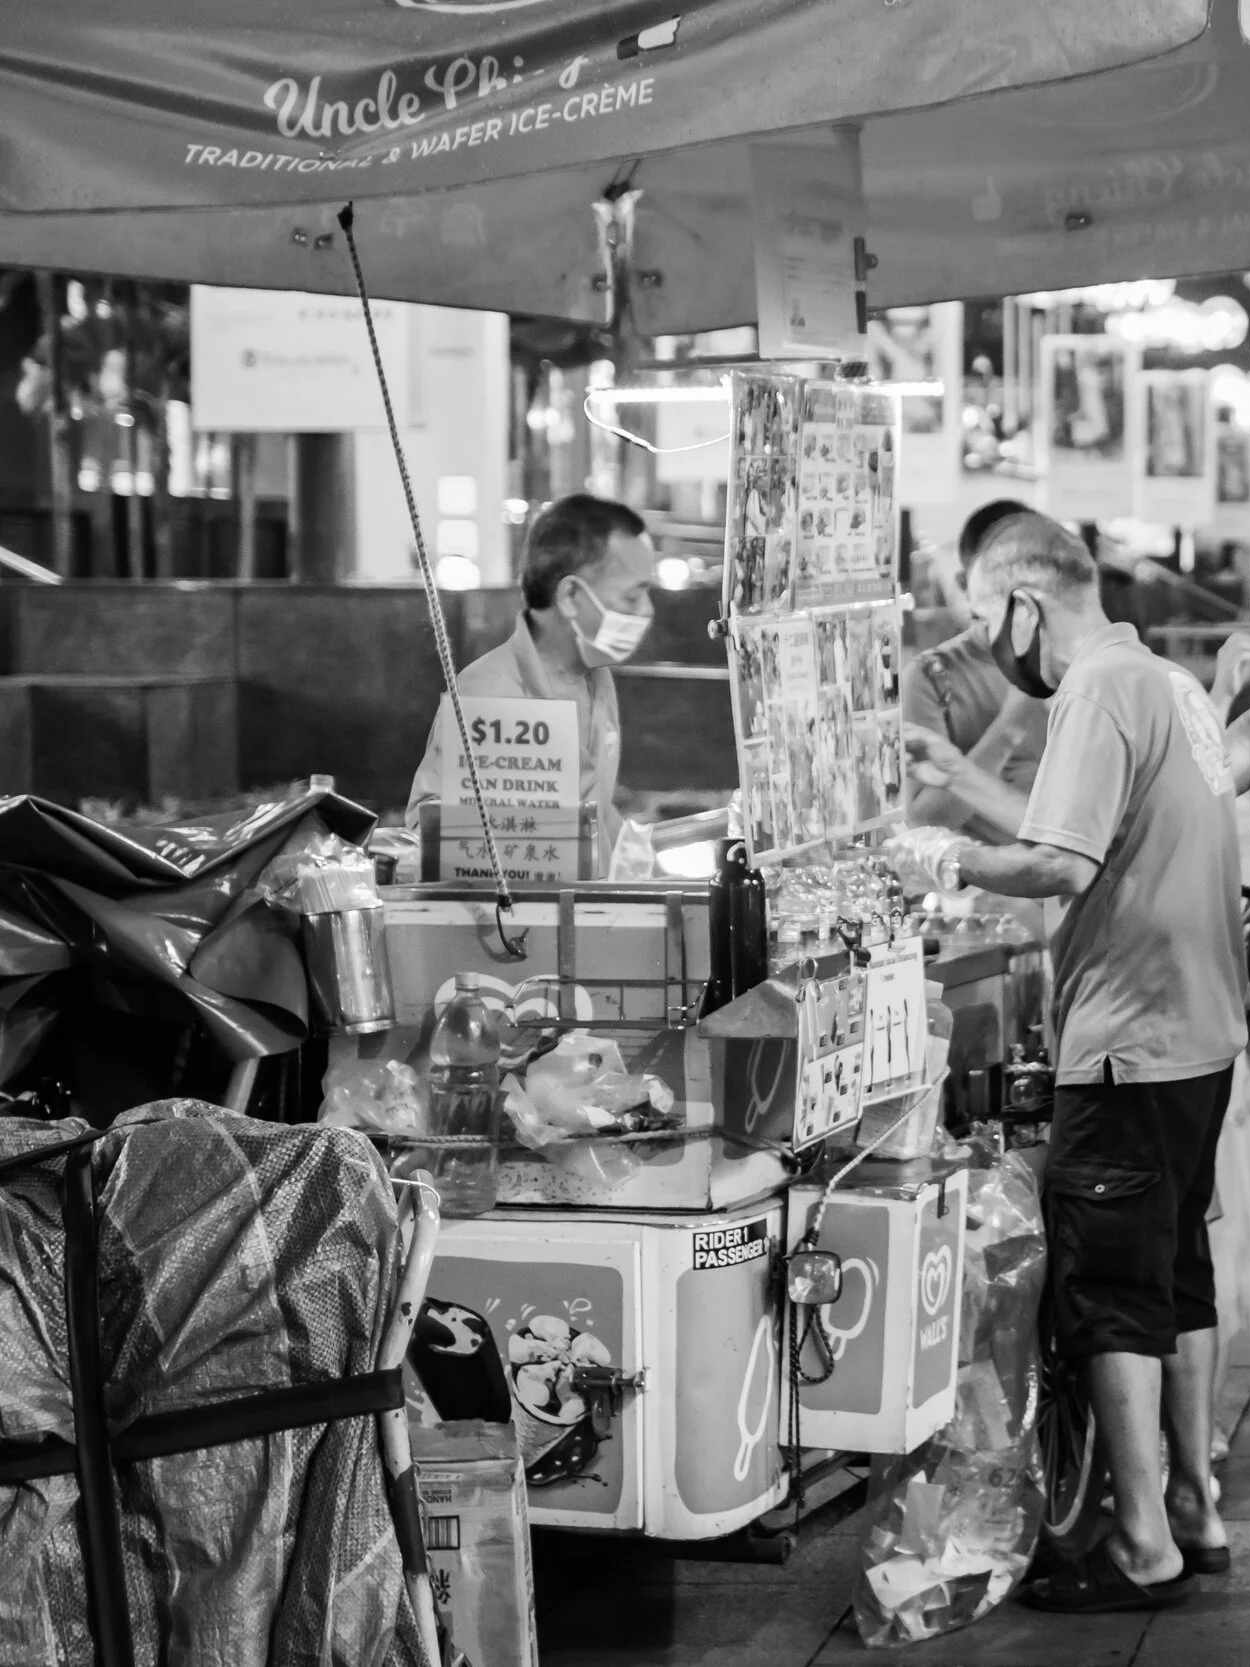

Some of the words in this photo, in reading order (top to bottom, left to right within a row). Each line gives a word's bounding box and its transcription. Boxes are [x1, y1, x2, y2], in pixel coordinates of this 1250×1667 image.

[263, 69, 427, 139] Uncle
[184, 144, 374, 173] TRADITIONAL
[382, 147, 401, 165] &
[410, 117, 501, 161] WAFER
[509, 77, 655, 134] ICE-CRÈME
[471, 716, 550, 746] $1.20
[458, 754, 562, 772] IE-CREAM
[502, 778, 560, 793] DRINK
[459, 796, 516, 808] MIERAL
[516, 798, 561, 809] WATER
[695, 1228, 742, 1250] RIDER
[743, 1226, 749, 1243] 1
[695, 1239, 763, 1268] PASSENGER
